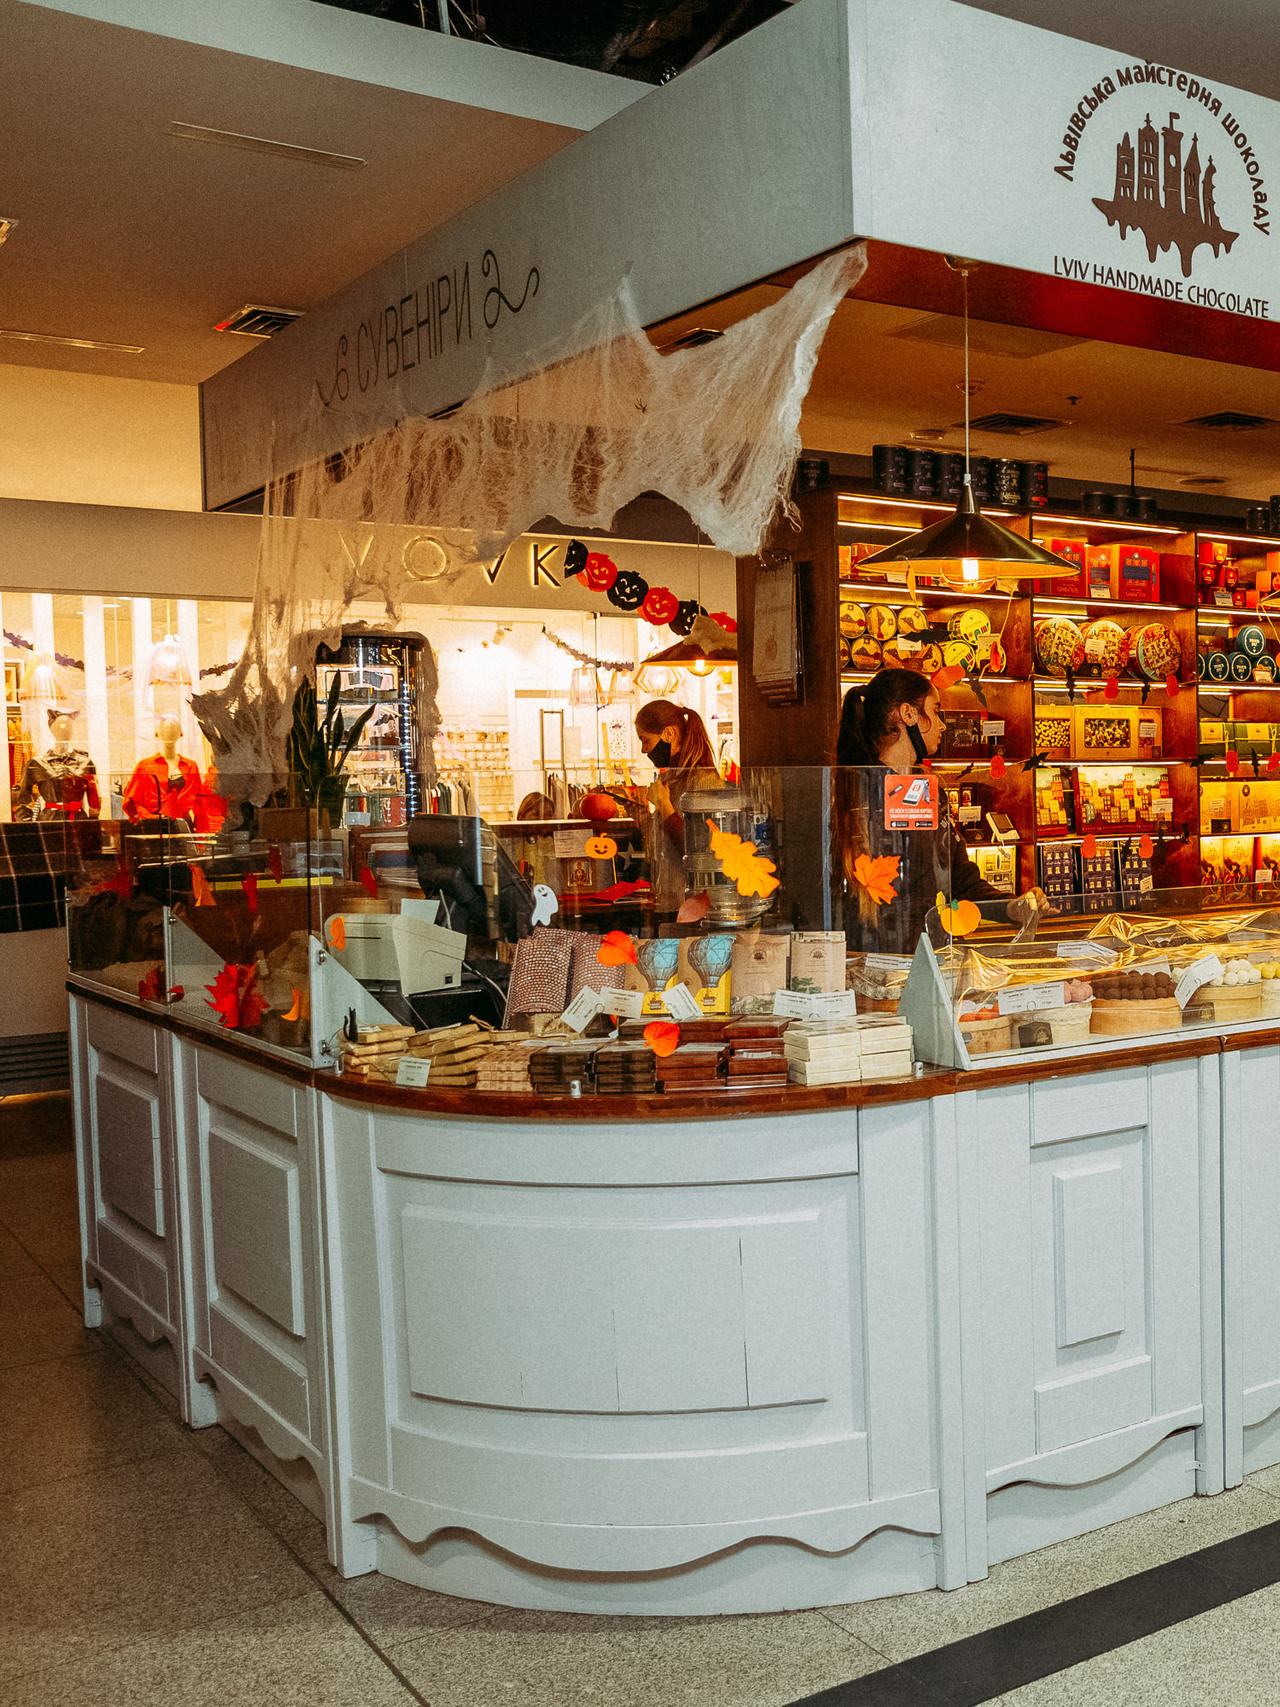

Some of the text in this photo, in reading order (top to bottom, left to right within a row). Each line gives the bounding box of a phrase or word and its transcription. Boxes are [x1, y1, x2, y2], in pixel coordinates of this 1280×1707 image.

[357, 261, 473, 393] СУВЕНІРИ
[1053, 254, 1270, 319] LVIV HANDMADE CHOCOLATE
